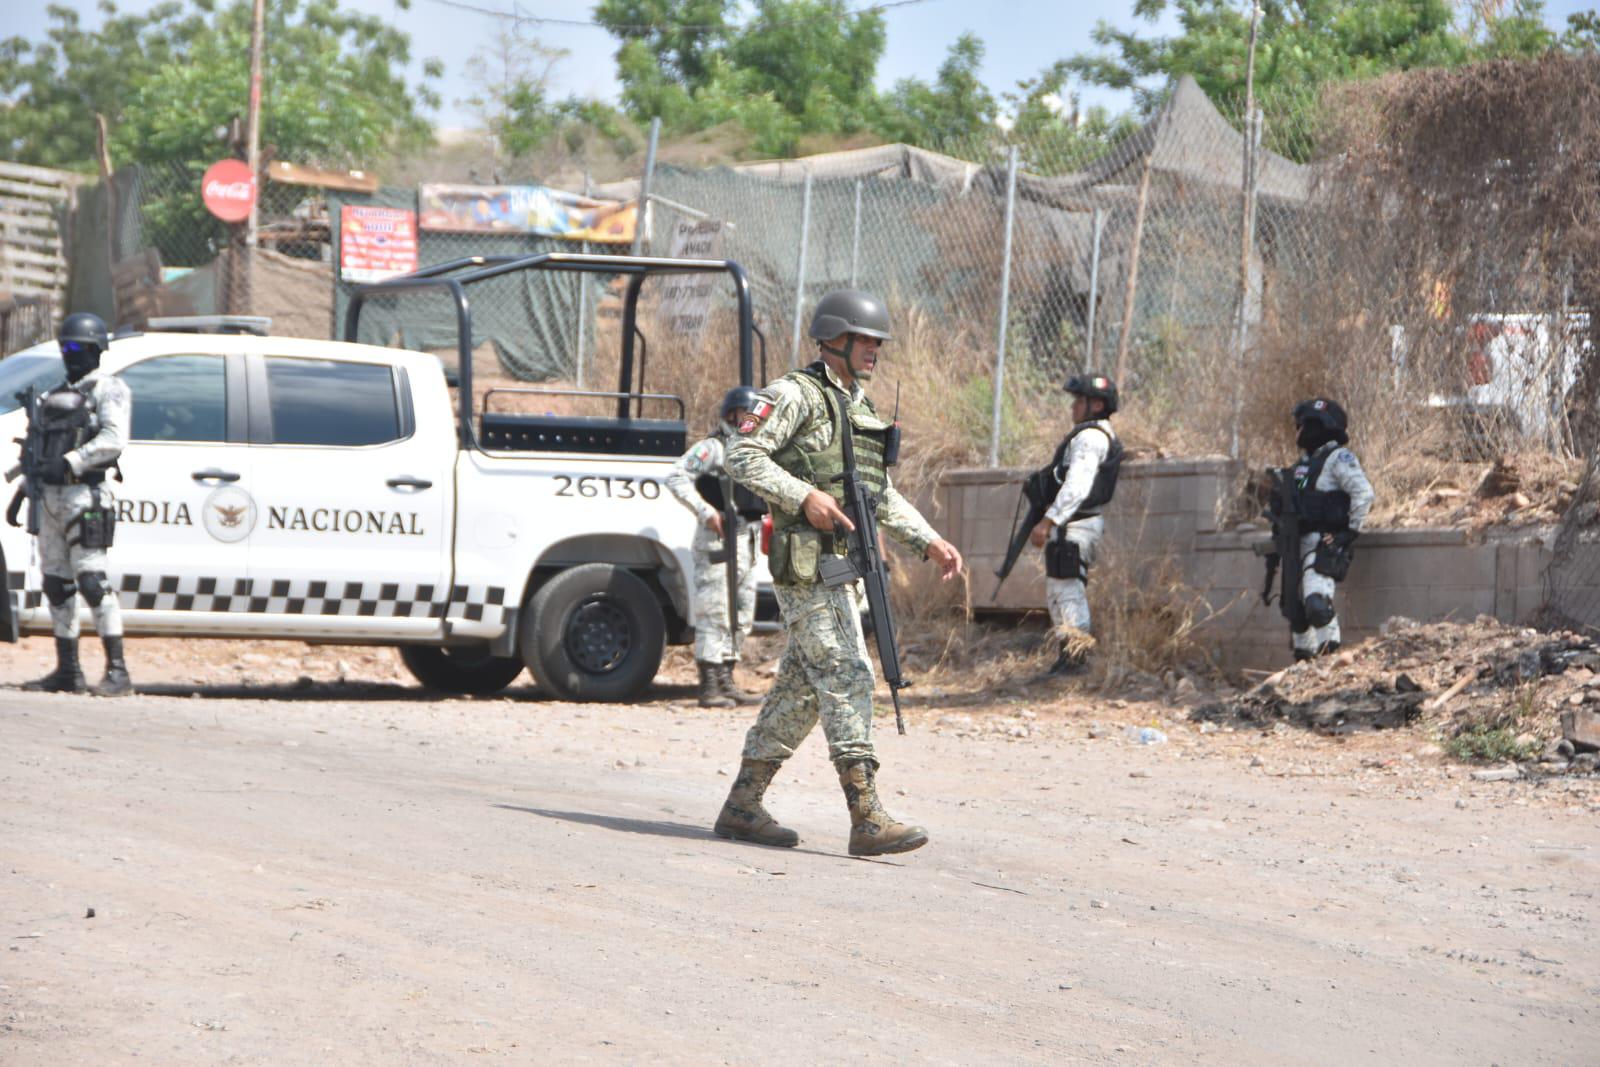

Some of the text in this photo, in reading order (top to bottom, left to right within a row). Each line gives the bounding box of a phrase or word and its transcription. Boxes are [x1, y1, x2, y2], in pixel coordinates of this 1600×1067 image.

[552, 474, 661, 500] 26130
[113, 499, 425, 536] RDIA NACIONAL
